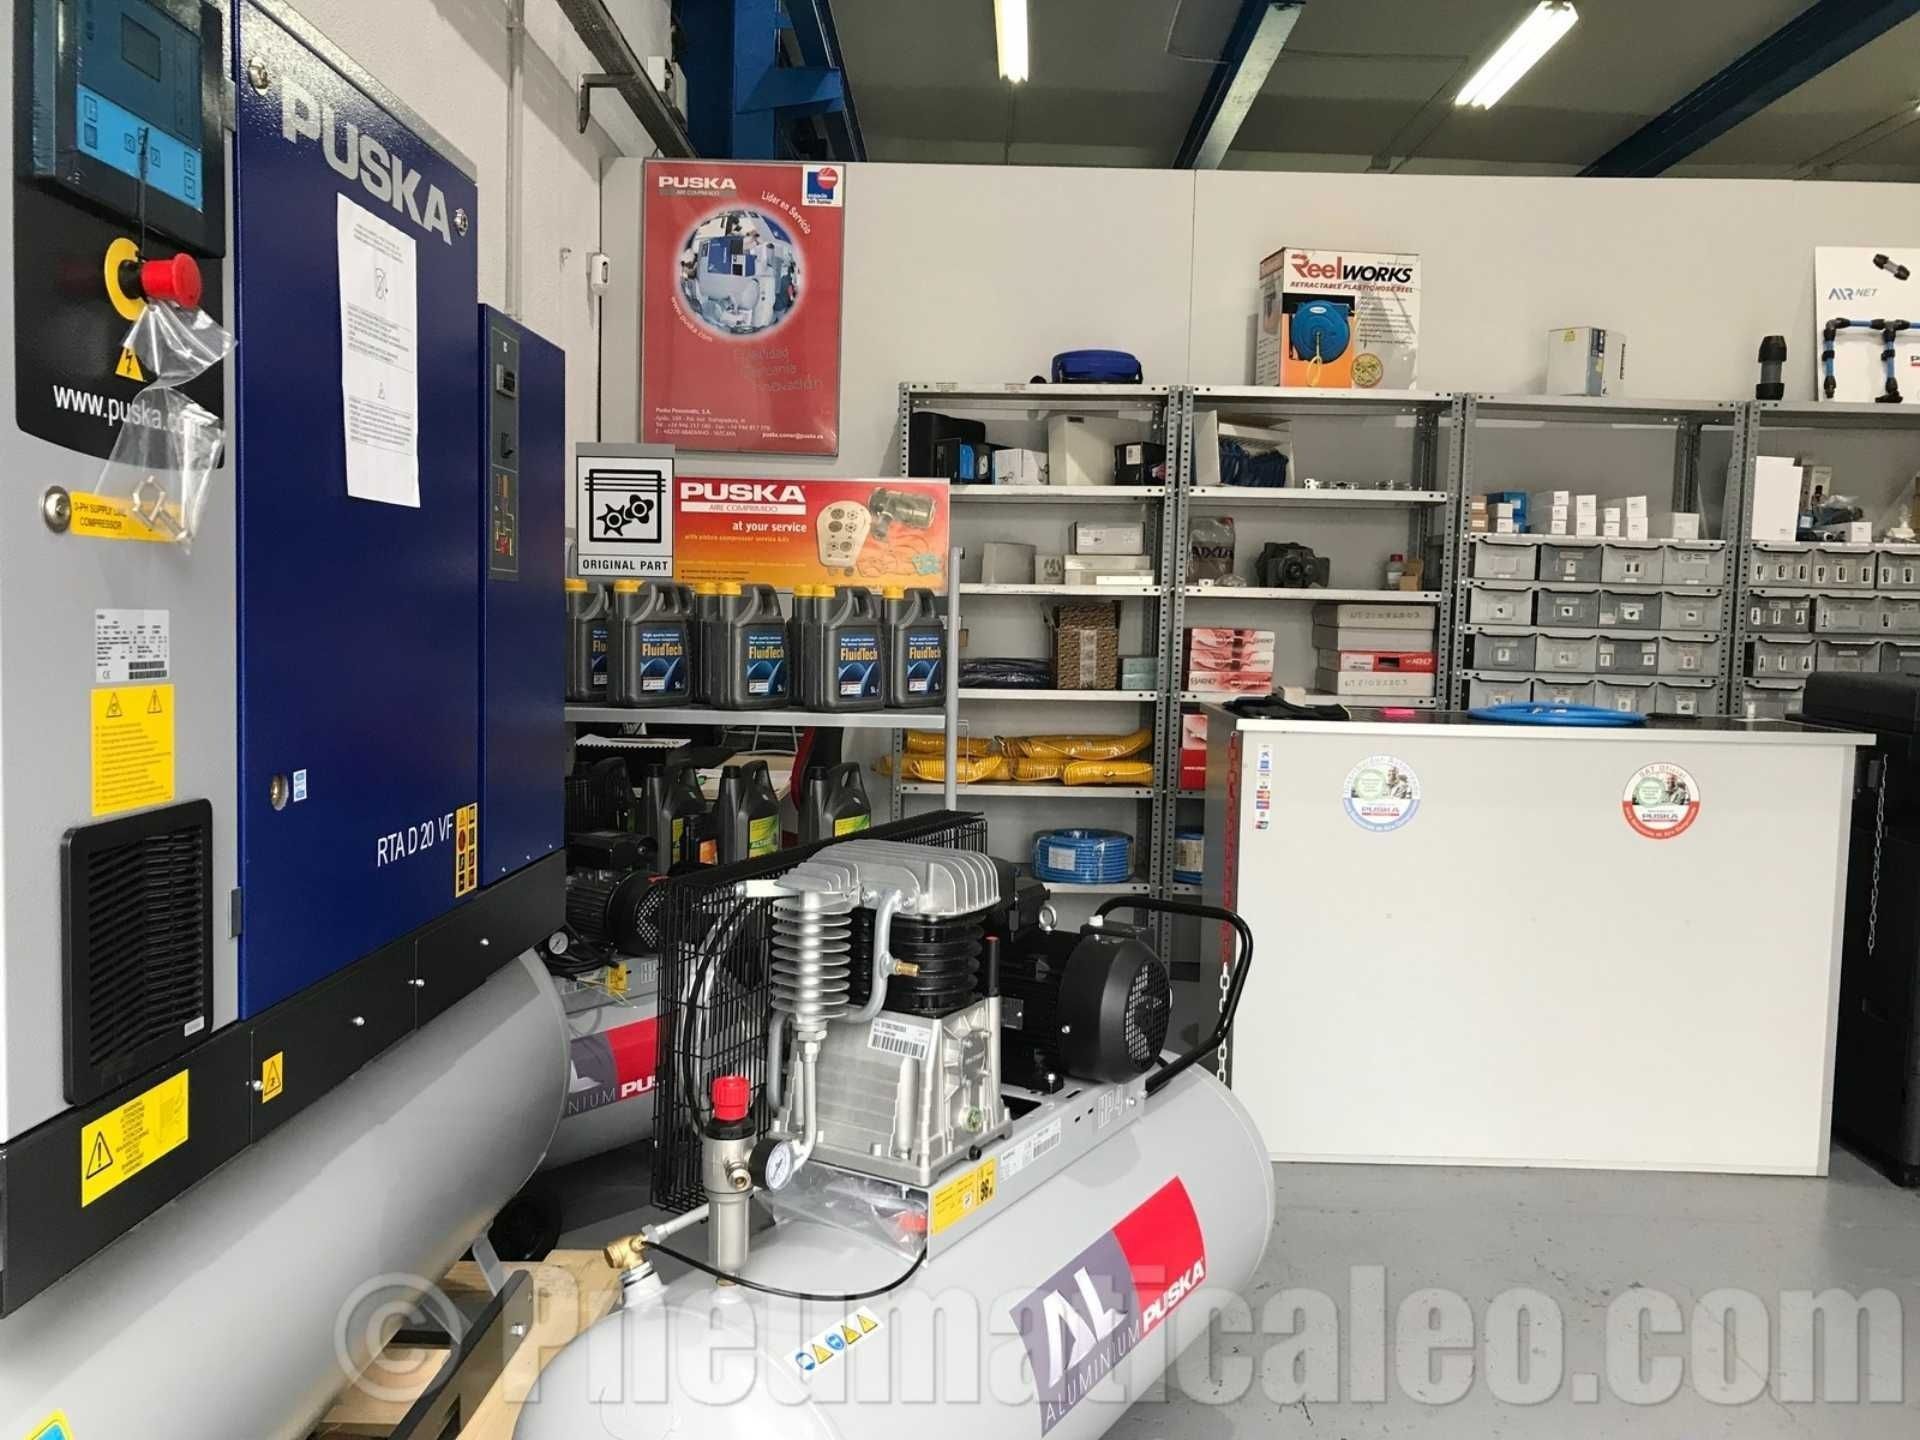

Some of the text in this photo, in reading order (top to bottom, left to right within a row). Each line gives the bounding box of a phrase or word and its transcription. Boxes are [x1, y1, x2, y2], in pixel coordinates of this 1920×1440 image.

[282, 78, 453, 246] PUSKA
[658, 176, 737, 189] PUSKA
[779, 200, 789, 211] en
[788, 206, 811, 235] Servicio
[1290, 254, 1413, 283] ReelWORKS
[1290, 281, 1342, 290] RETRACTABLE
[1342, 284, 1375, 293] PLASTIC
[1855, 287, 1878, 297] NET
[680, 482, 806, 502] PUSKA
[708, 503, 725, 512] AIRE
[80, 517, 122, 530] COMPRESSOR
[732, 521, 808, 535] at your service
[583, 560, 635, 570] ORIGINAL
[641, 561, 668, 571] PART
[642, 643, 683, 656] FluidTech
[749, 646, 785, 659] FluidTech
[841, 648, 878, 661] FluidTech
[909, 647, 942, 659] FluidTech
[377, 812, 454, 868] RTA D 20 VF
[1142, 1255, 1205, 1334] PUSKA
[1042, 1265, 1129, 1388] AL
[1044, 1318, 1141, 1428] ALUMINIUM
